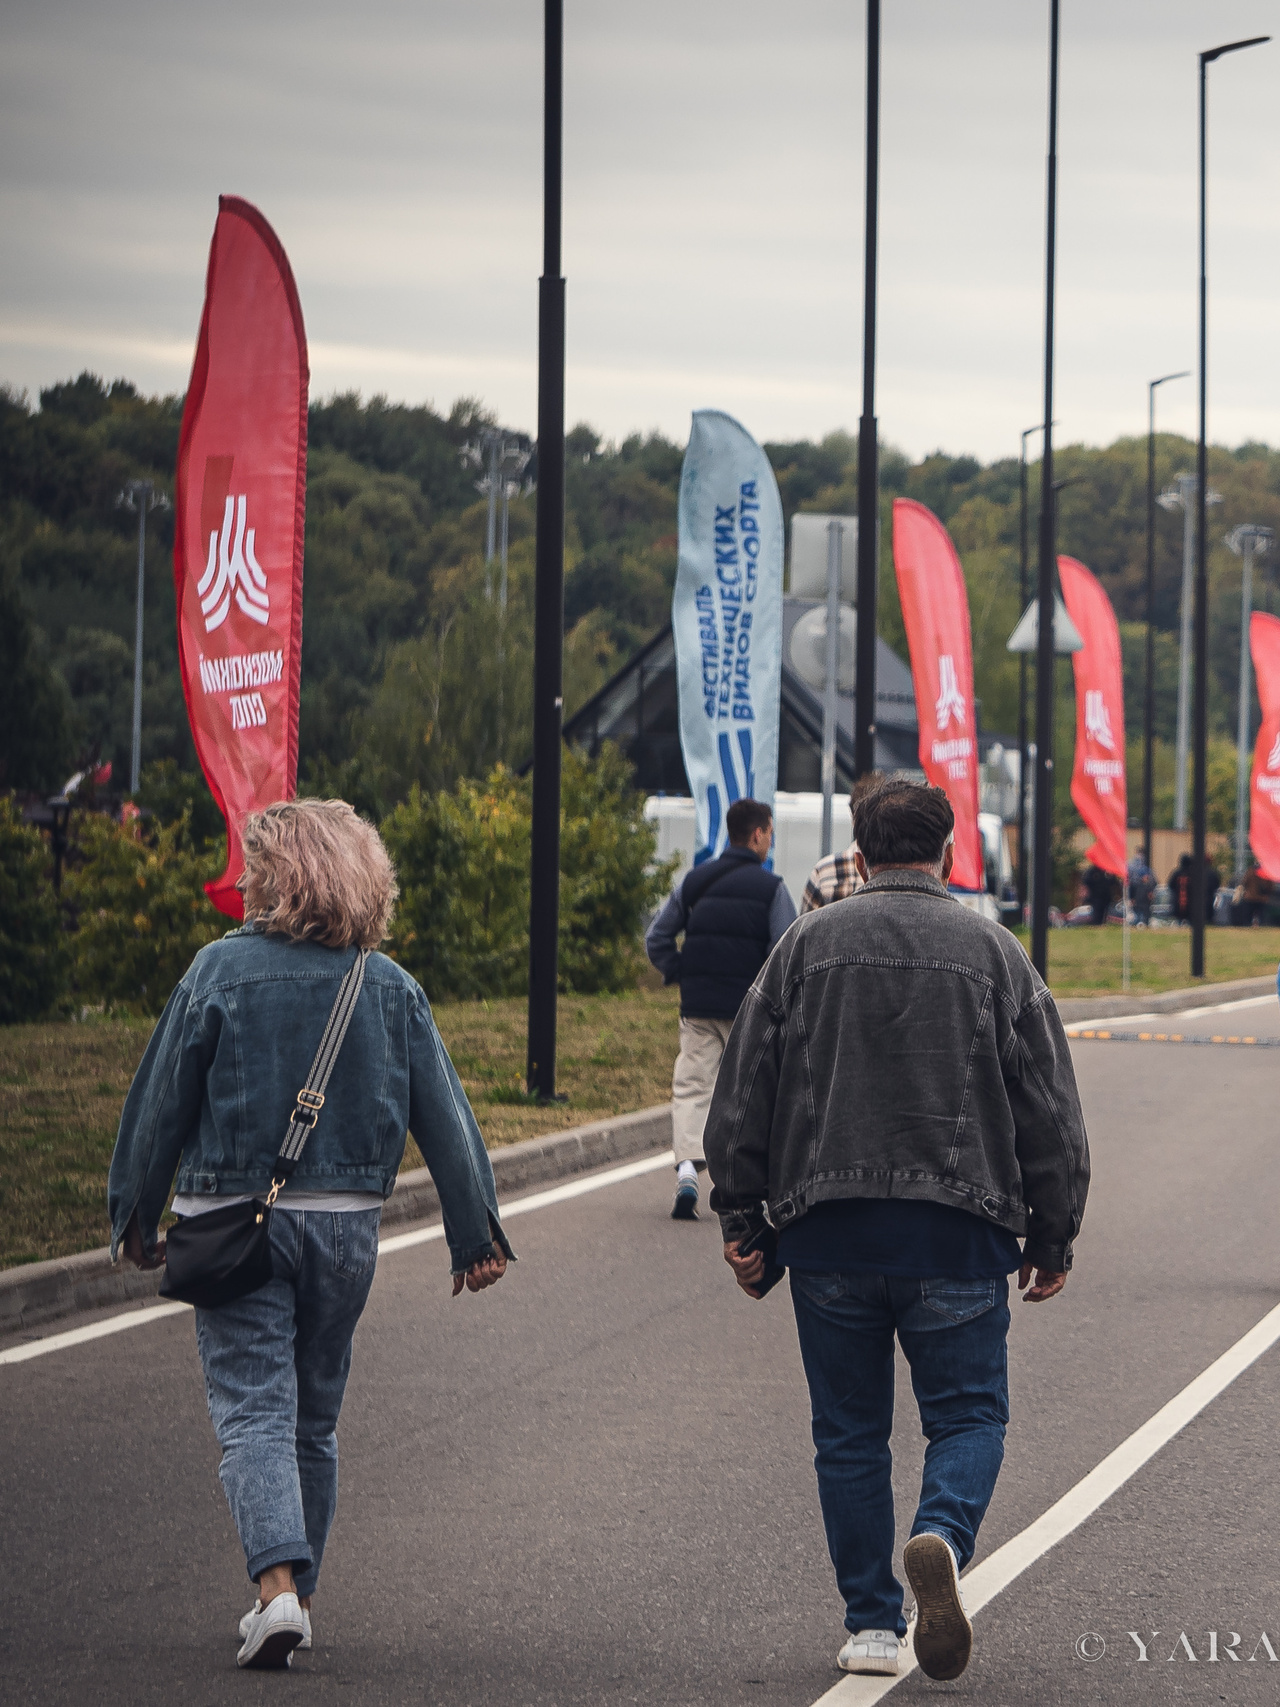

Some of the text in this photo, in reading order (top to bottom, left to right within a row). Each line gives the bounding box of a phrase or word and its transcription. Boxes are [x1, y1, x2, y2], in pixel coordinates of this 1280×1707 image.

[695, 583, 720, 719] ФЕСТИВАЛЬ
[713, 503, 742, 721] ТЕХНИЧЕСКИХ
[732, 479, 760, 722] ВИДОВ СПОРТА
